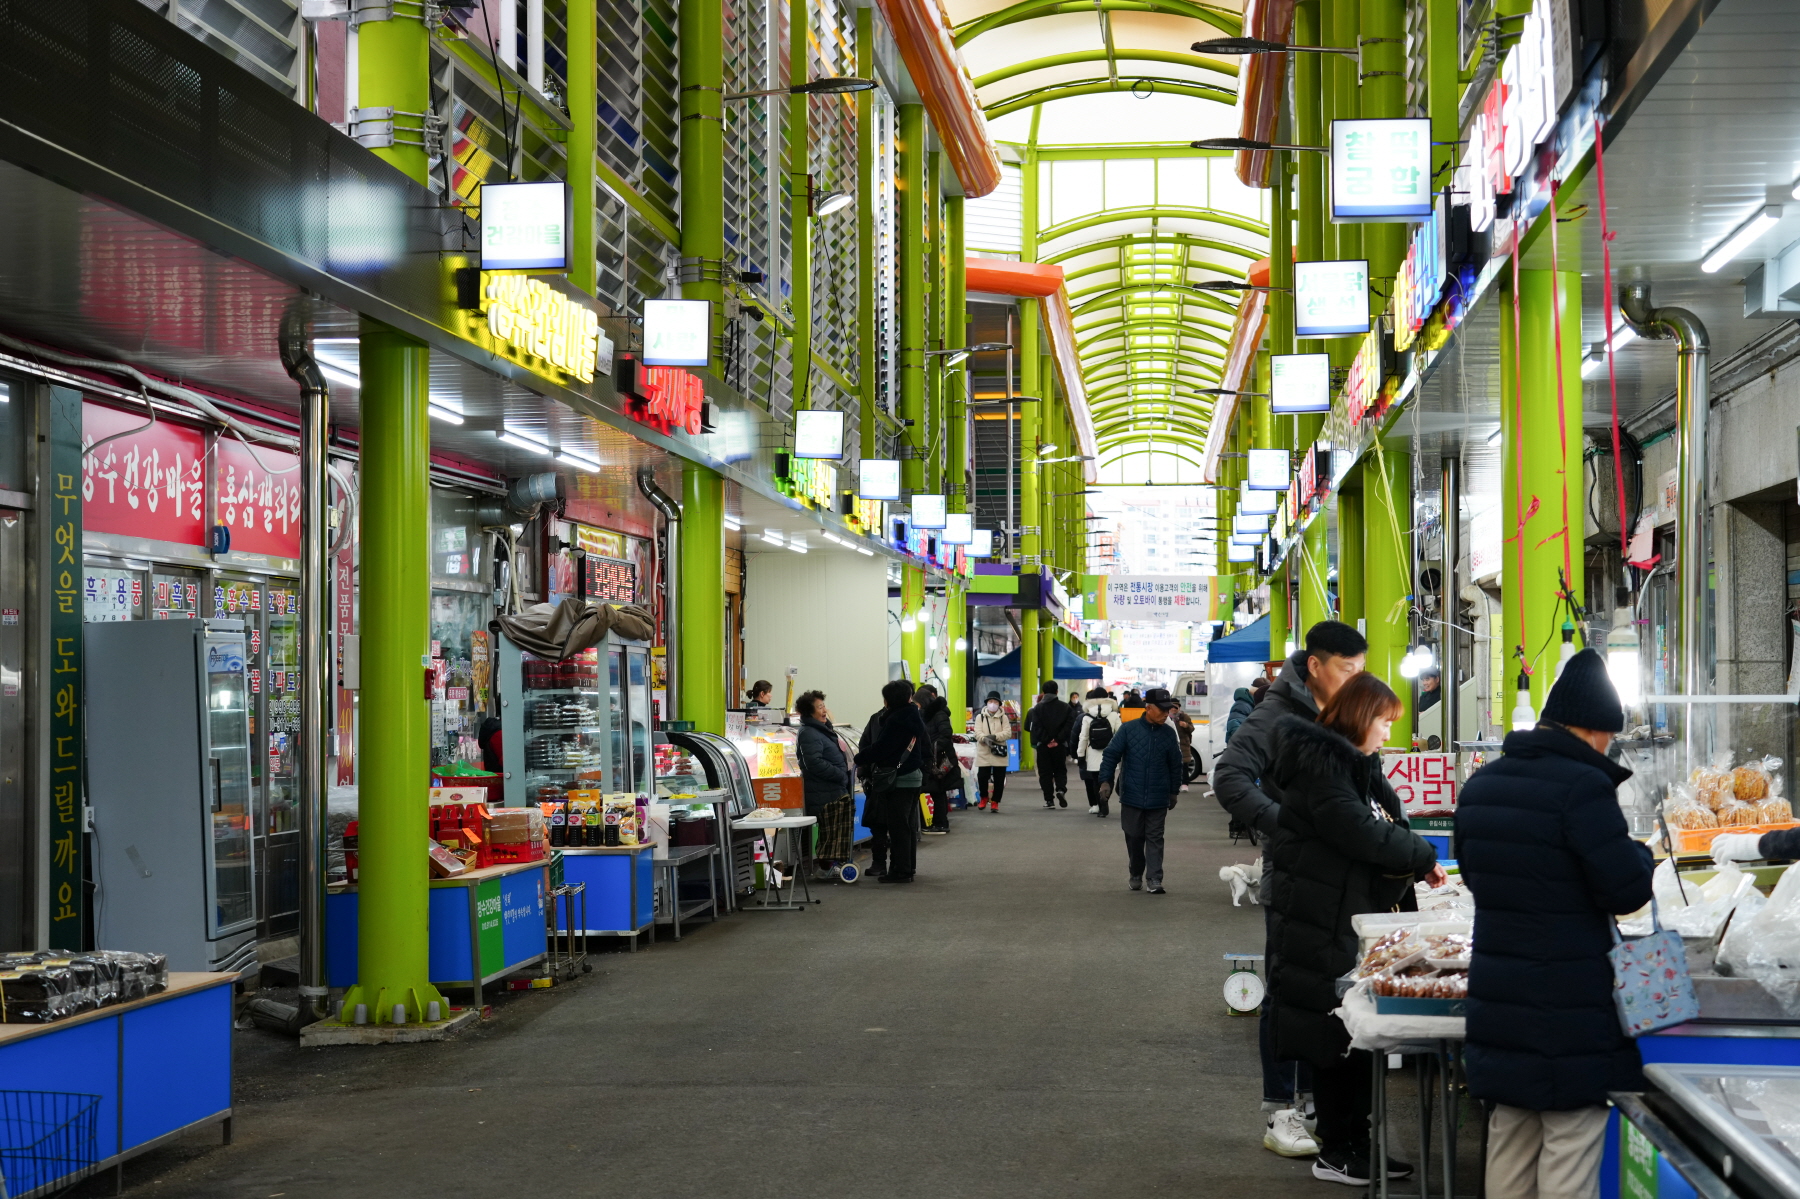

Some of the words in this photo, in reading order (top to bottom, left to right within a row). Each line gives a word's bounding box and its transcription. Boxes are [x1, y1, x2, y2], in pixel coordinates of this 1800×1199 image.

[1344, 130, 1420, 161] 찰떡
[1345, 165, 1421, 196] 궁합
[487, 222, 562, 247] 건강마을
[54, 473, 78, 614] 무엇을
[1107, 583, 1113, 593] 이
[1113, 583, 1129, 593] 구역은
[1129, 582, 1154, 593] 전통시장
[1154, 583, 1179, 593] 이용고객의
[1180, 582, 1197, 593] 안전을
[1198, 583, 1208, 593] 위해
[1113, 594, 1126, 606] 차량
[1133, 594, 1157, 606] 오토바이
[1157, 595, 1173, 606] 통행을
[1173, 594, 1202, 606] 제한합니다.
[53, 638, 79, 923] 도와드릴까요
[1386, 755, 1457, 806] 생닭
